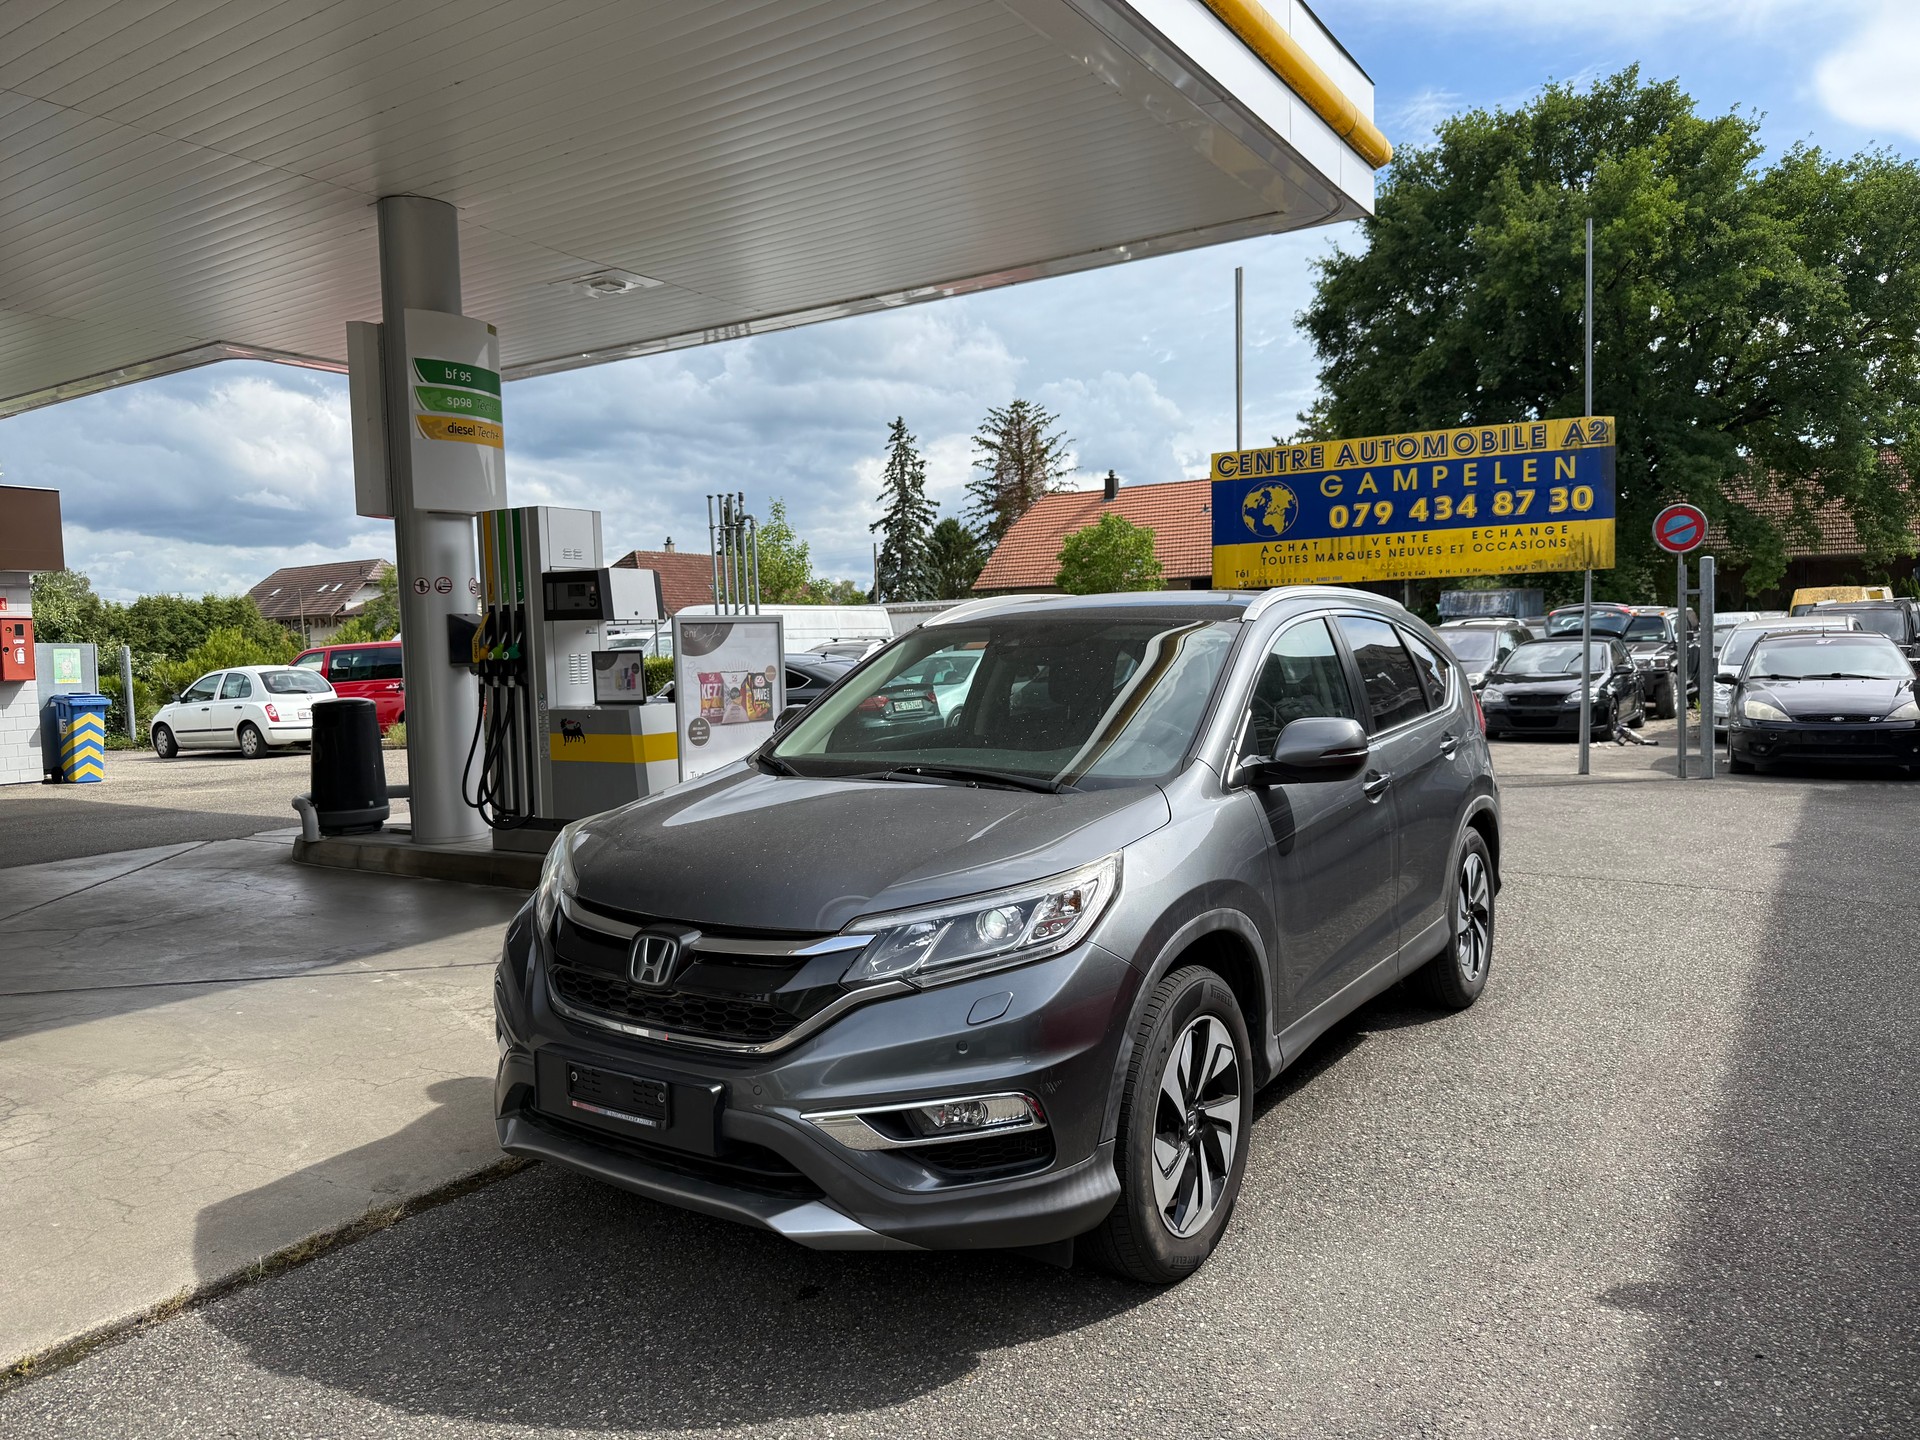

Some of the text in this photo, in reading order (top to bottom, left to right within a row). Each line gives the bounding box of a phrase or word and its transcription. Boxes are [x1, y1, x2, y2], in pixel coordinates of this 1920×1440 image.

[445, 367, 472, 382] bf 95
[447, 396, 473, 409] sp98
[447, 422, 500, 440] diesel Tech+
[1216, 419, 1609, 477] CENTRE AUTOMOBILE A2
[1319, 455, 1576, 498] GAMPELEN
[1328, 485, 1594, 529] 079 434 87 30
[1261, 524, 1568, 553] ACHAT VENTE ECHANGE
[1261, 538, 1567, 566] TOUTES MARQUES NEUVES ET OCCASIONS
[588, 593, 597, 608] 5
[683, 628, 696, 638] eni
[1210, 984, 1233, 1008] PIRELLI
[1169, 1255, 1200, 1270] PIRELLI
